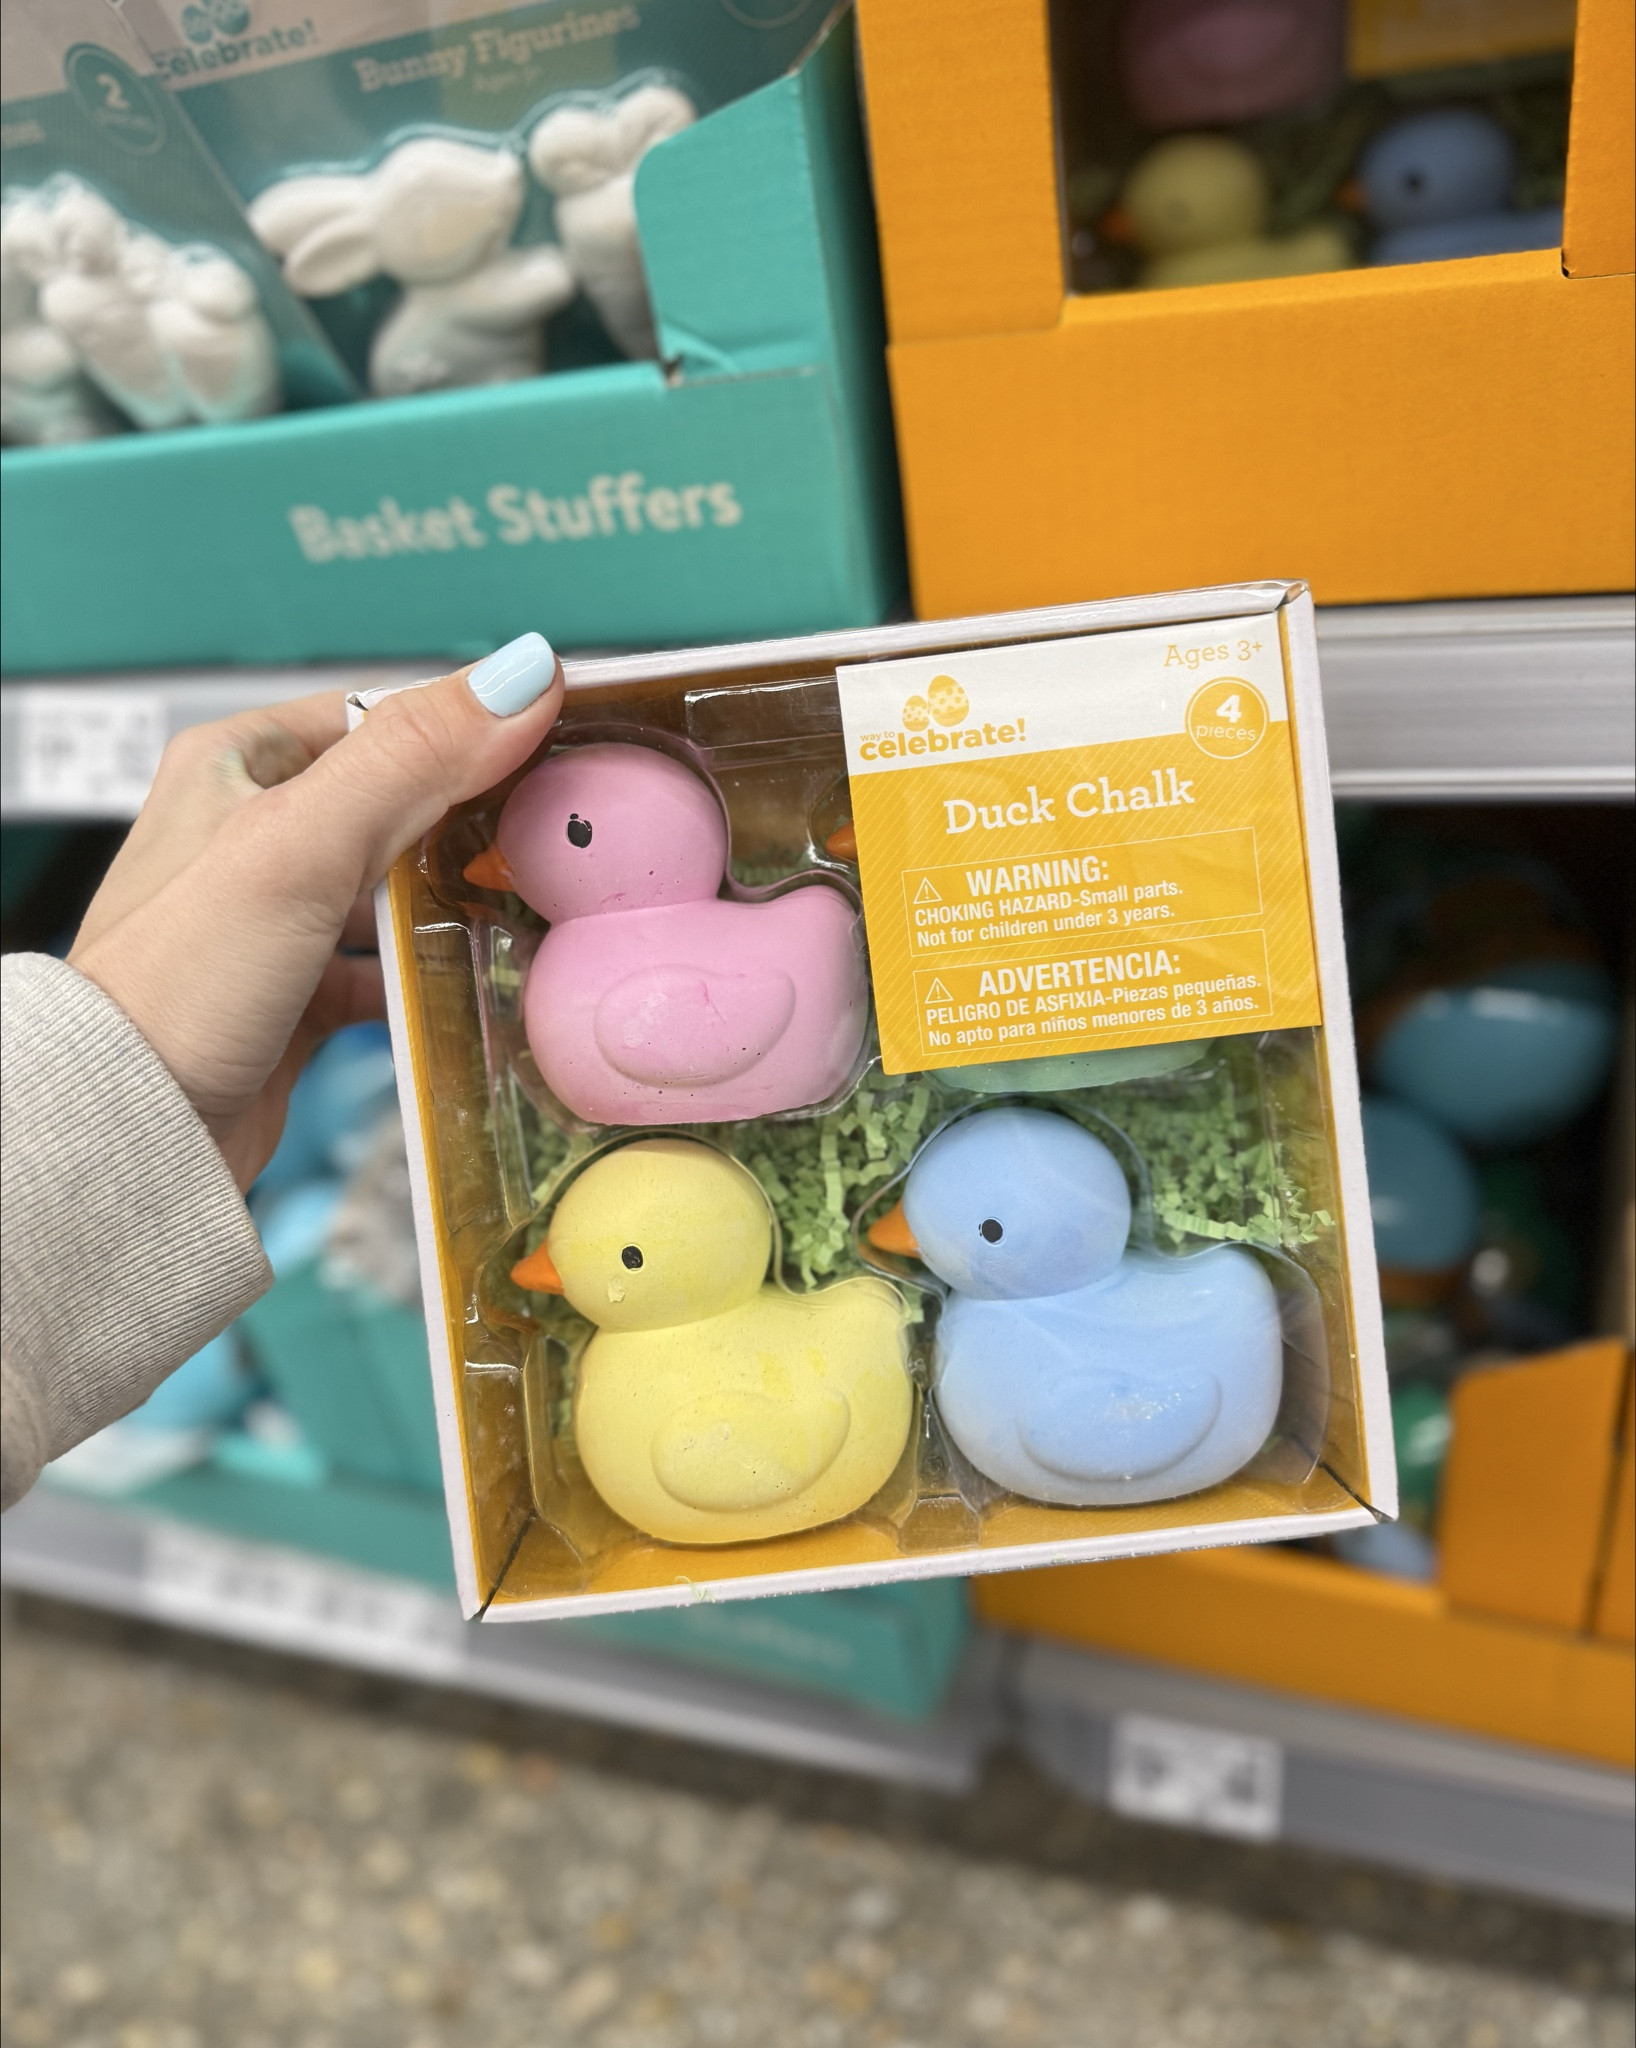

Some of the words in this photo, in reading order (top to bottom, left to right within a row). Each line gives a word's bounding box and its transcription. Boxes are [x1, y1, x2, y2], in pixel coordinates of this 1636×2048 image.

[352, 44, 470, 92] Bunny
[469, 4, 641, 75] Figurines
[289, 496, 487, 563] Basket
[487, 470, 743, 544] Stuffers
[1164, 644, 1229, 670] Ages
[1237, 639, 1264, 662] 3+
[1196, 722, 1258, 743] pieces
[1215, 694, 1243, 724] 4
[859, 731, 882, 744] way
[883, 728, 896, 740] to
[859, 718, 1027, 762] celebrate!
[943, 786, 1056, 835] Duck
[1066, 768, 1196, 819] Chalk
[966, 855, 1110, 897] WARNING:
[915, 901, 994, 927] CHOKING
[999, 885, 1129, 917] HAZARD-Small
[1133, 878, 1184, 902] parts.
[917, 927, 948, 949] Not
[951, 924, 974, 943] for
[979, 915, 1049, 941] children
[1053, 909, 1103, 933] under
[1107, 907, 1119, 925] 3
[1123, 903, 1176, 927] years.
[978, 949, 1182, 997] ADVERTENCIA:
[926, 1000, 1001, 1026] PELIGRO
[1007, 997, 1030, 1017] DE
[1034, 983, 1169, 1014] ASFIXIA-Piezas
[1173, 972, 1263, 1001] pequeñas.
[928, 1028, 951, 1047] No
[956, 1025, 994, 1047] apto
[998, 1021, 1037, 1043] para
[1041, 1014, 1088, 1034] niños
[1092, 1007, 1167, 1029] menores
[1171, 1001, 1193, 1020] de
[1196, 998, 1208, 1016] 3
[1212, 994, 1260, 1014] años.
